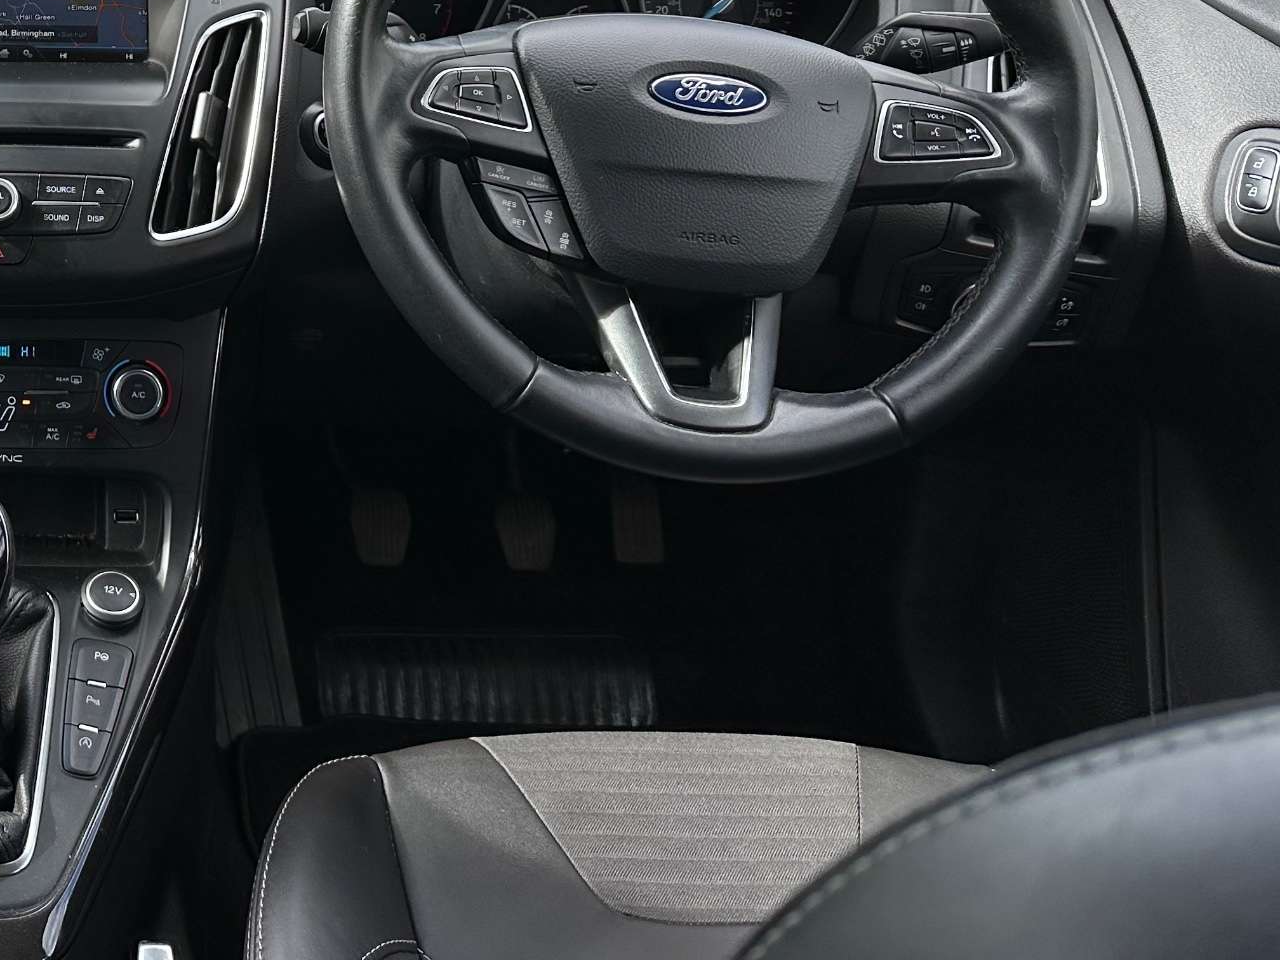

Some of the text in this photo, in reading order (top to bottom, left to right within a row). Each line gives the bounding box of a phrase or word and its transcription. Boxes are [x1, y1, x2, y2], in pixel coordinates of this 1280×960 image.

[433, 3, 441, 15] 7
[655, 5, 669, 15] 20
[763, 8, 783, 18] 140
[11, 29, 55, 38] Birmingham
[472, 88, 484, 96] OK
[675, 76, 744, 106] Ford
[46, 186, 76, 194] SOURCE
[43, 214, 70, 222] SOUND
[87, 214, 104, 223] DISP
[680, 230, 741, 246] AIRBAG
[131, 391, 146, 399] A/C
[45, 432, 60, 441] A/C
[103, 585, 123, 596] 12V
